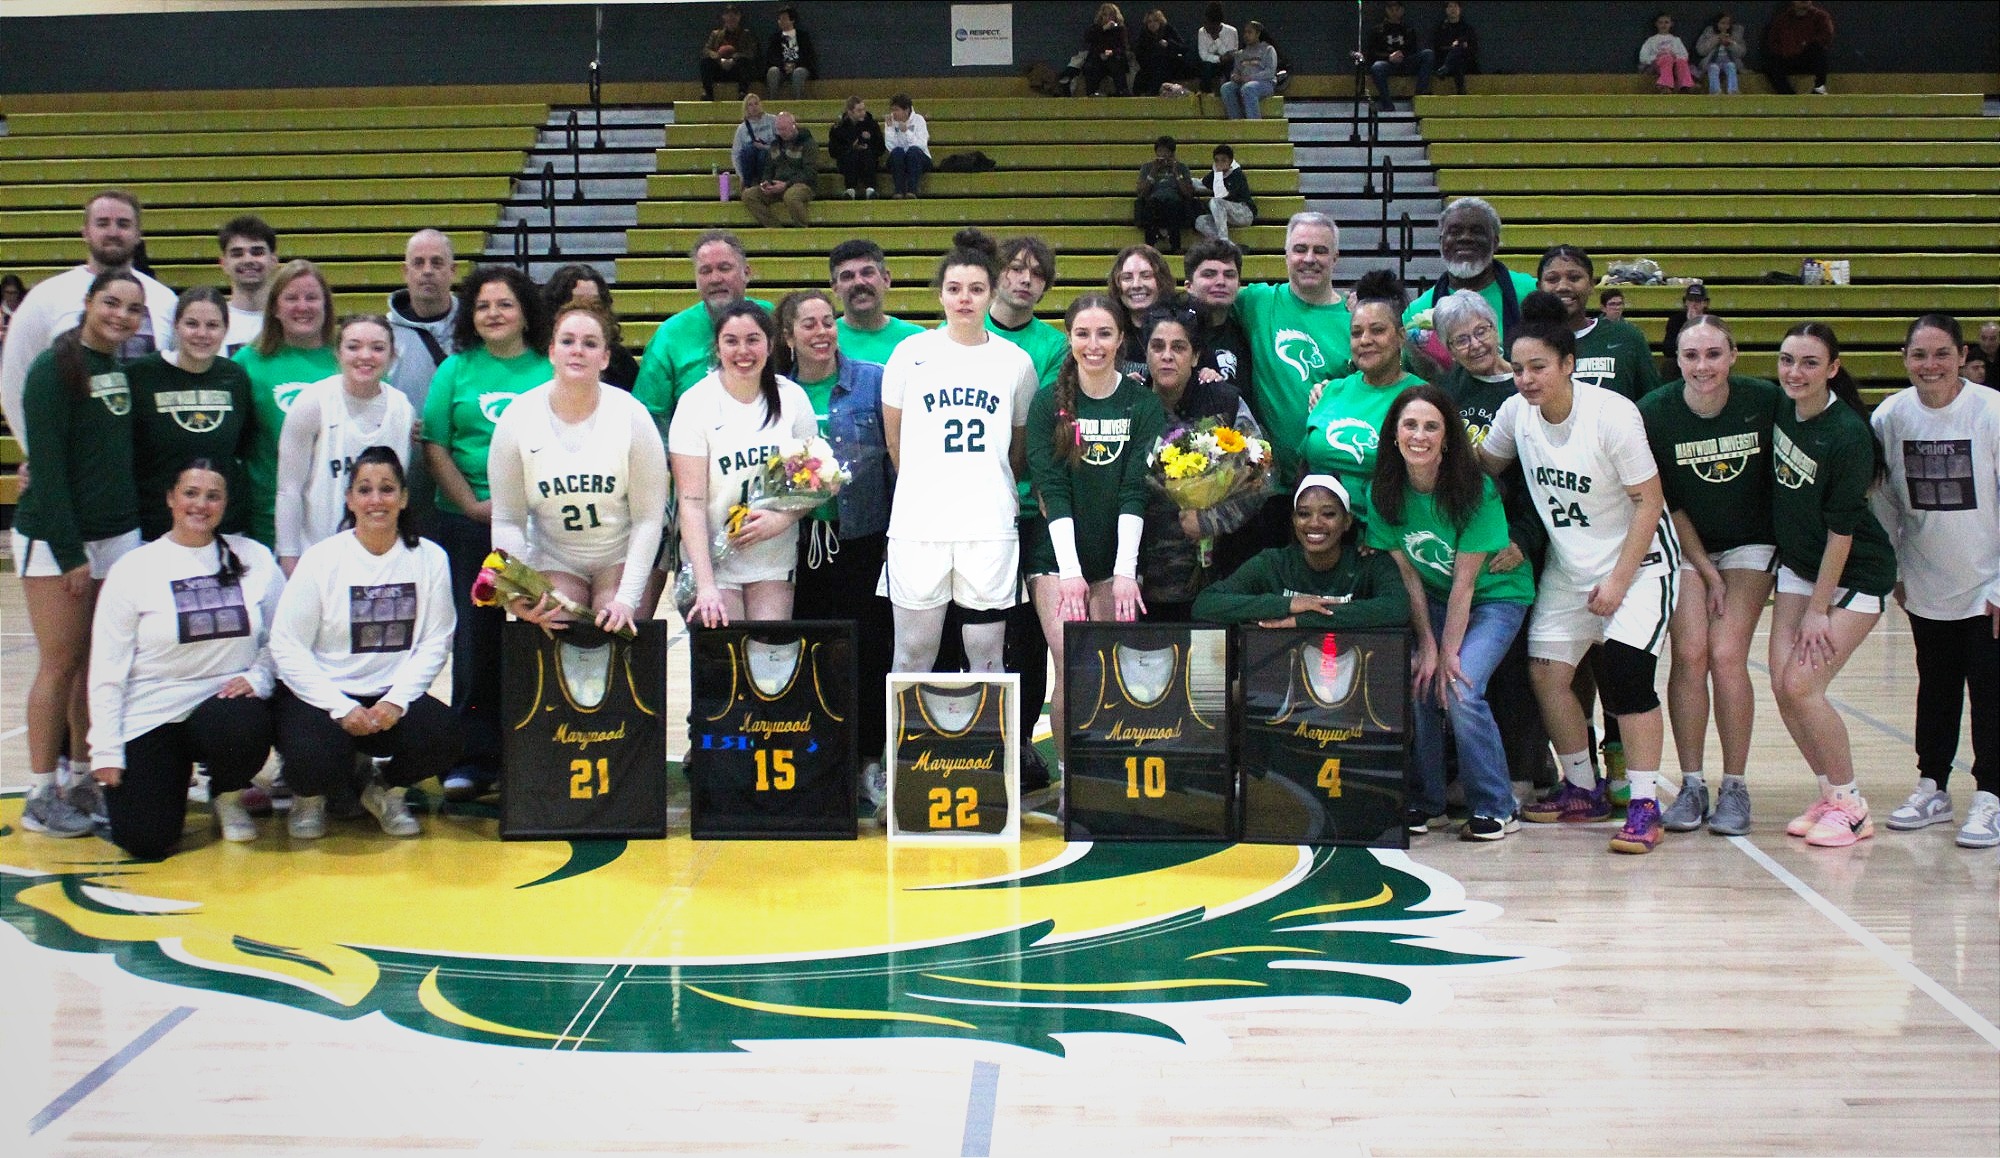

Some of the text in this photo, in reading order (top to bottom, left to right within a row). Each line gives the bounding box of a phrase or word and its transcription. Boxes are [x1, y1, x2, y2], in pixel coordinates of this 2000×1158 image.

[923, 387, 1000, 414] PACERS
[944, 418, 985, 453] 22
[1675, 432, 1759, 458] MARYWOOD UNIVERSITY
[1915, 441, 1956, 455] Seniors
[538, 474, 617, 498] PACERS
[1531, 466, 1592, 494] ACERS
[561, 503, 601, 531] 21
[1548, 496, 1591, 528] 24
[552, 720, 626, 750] Marywood
[739, 711, 812, 740] Marywood
[1105, 717, 1182, 747] Marywood
[1294, 718, 1364, 749] Marywood
[569, 758, 610, 799] 21
[754, 749, 796, 791] 15
[911, 749, 994, 778] Marywood
[1125, 756, 1166, 798] 10
[1317, 758, 1342, 798] 4
[928, 787, 980, 828] 22
